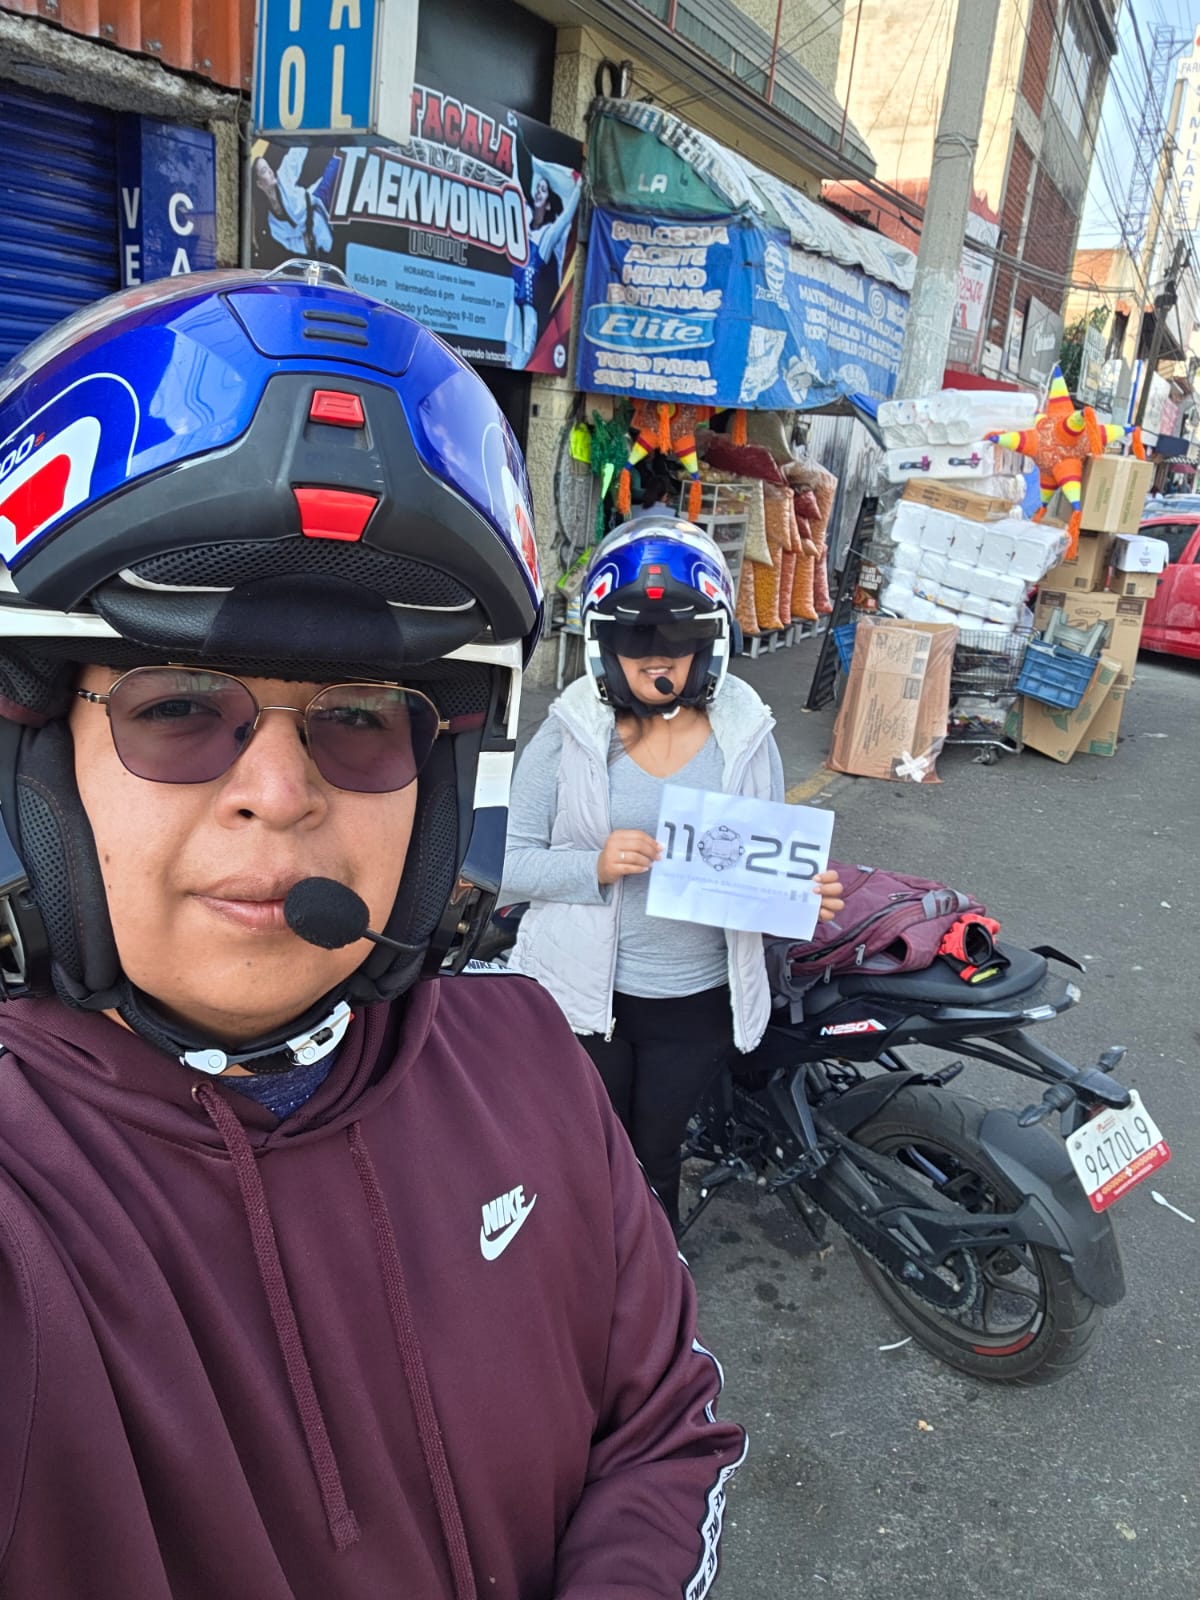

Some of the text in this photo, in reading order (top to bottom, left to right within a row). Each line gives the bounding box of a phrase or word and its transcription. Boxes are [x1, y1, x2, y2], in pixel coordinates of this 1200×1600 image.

[637, 173, 668, 193] LA
[334, 147, 527, 262] TAEKWONDO
[612, 219, 729, 245] DULCERIA
[409, 230, 467, 266] OLYMPIC
[624, 244, 707, 266] ACEITE
[354, 273, 369, 284] Kids
[375, 279, 388, 288] pm
[622, 264, 707, 288] HUEVO
[395, 280, 437, 298] Intermedios
[443, 291, 455, 301] pm
[607, 282, 723, 310] BOTANAS
[416, 306, 422, 317] y
[423, 304, 460, 322] Domingos
[599, 313, 703, 343] Elite
[595, 351, 711, 377] TODO PARA
[593, 369, 718, 396] SUS FIESTAS
[820, 1019, 869, 1036] N250
[481, 1184, 526, 1237] NIKE
